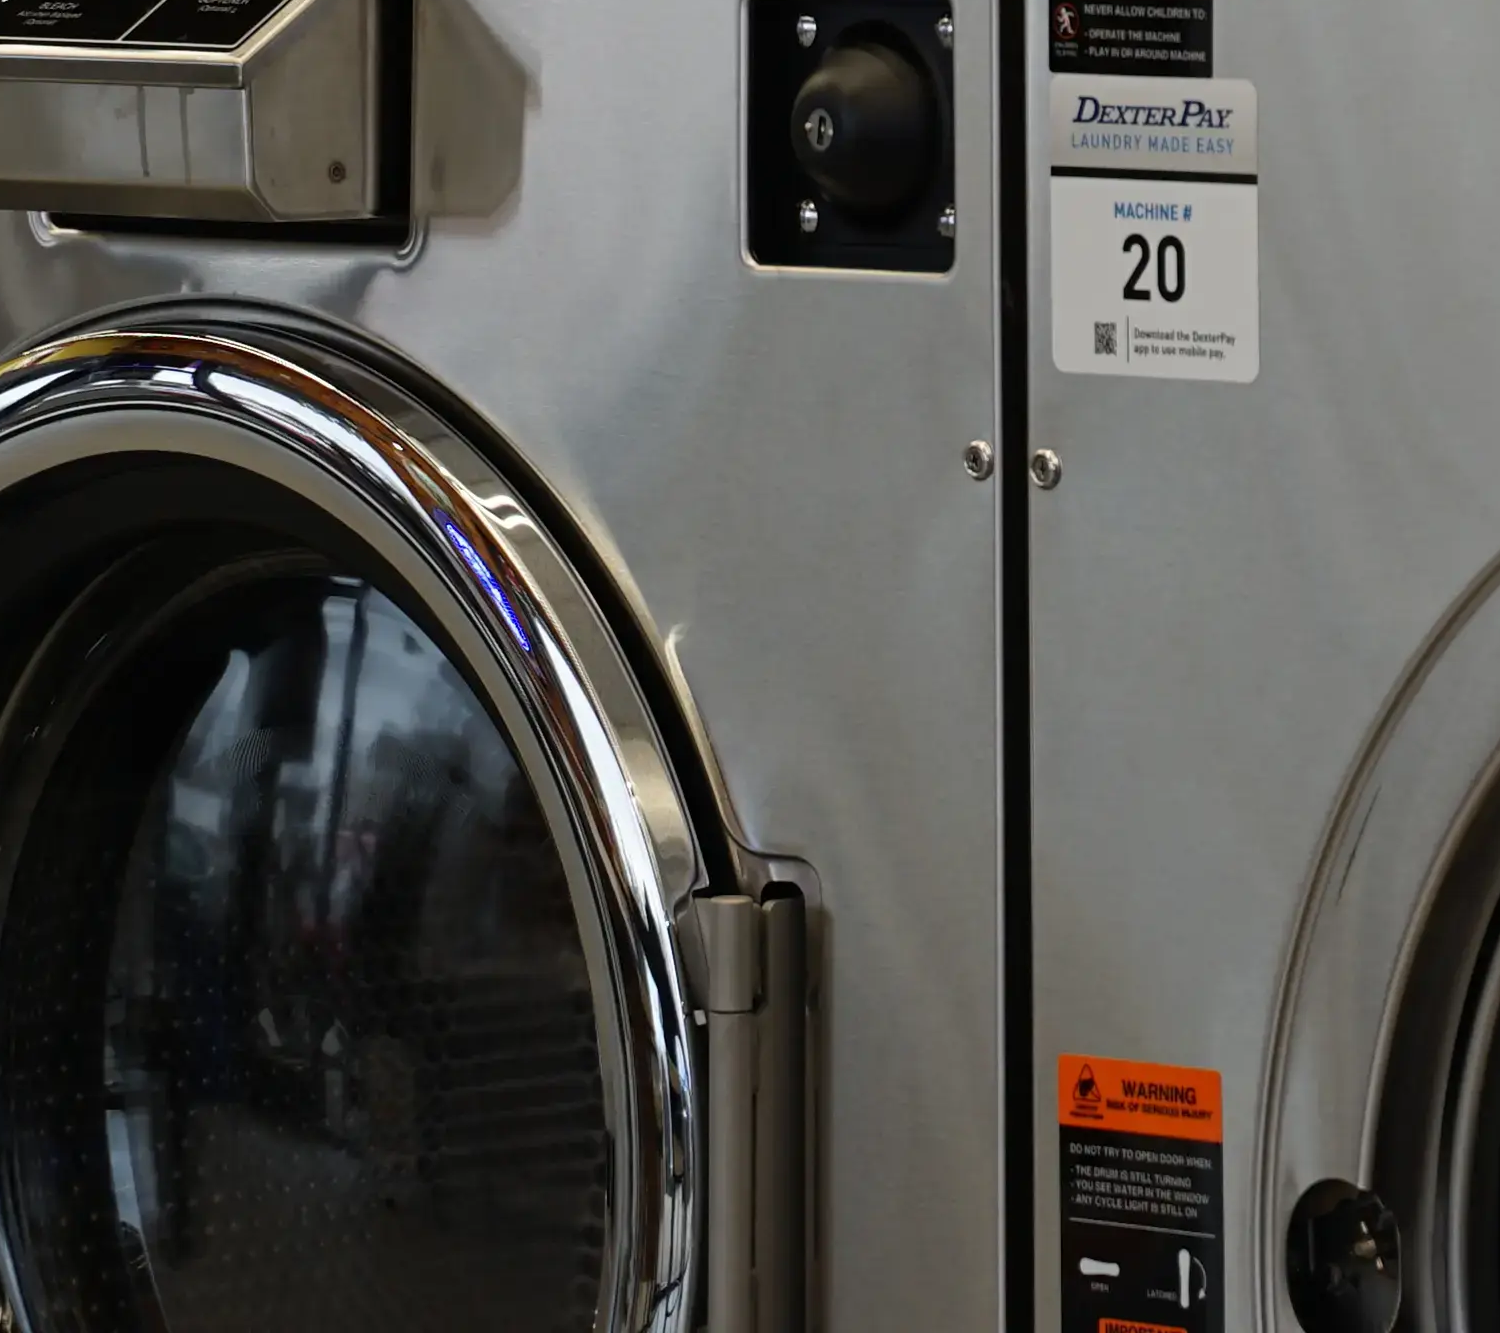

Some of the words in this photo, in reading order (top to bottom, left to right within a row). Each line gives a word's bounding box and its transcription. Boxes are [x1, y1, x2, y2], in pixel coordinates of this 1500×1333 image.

[1084, 3, 1114, 15] NEVER
[1114, 4, 1147, 17] ALLOW
[1147, 6, 1190, 19] CHILDREN
[1089, 46, 1109, 58] PLAY
[1071, 133, 1142, 152] LAUNDRY
[1148, 136, 1190, 153] MADE
[1196, 138, 1235, 154] EASY
[1114, 201, 1178, 221] MACHINE
[1183, 204, 1192, 221] #
[1122, 233, 1186, 303] 20
[1134, 328, 1176, 341] Download
[1177, 330, 1191, 342] the
[1192, 330, 1236, 346] DexterPay
[1134, 345, 1149, 357] app
[1151, 344, 1160, 355] to
[1162, 346, 1176, 356] use
[1178, 344, 1207, 357] mobile
[1122, 1079, 1197, 1105] WARNING
[1070, 1142, 1082, 1155] DO
[1084, 1144, 1102, 1157] NOT
[1104, 1146, 1121, 1159] TRY
[1122, 1148, 1134, 1160] TO
[1135, 1150, 1159, 1163] OPEN
[1160, 1153, 1184, 1166] DOOR
[1076, 1165, 1092, 1177] THE
[1076, 1180, 1094, 1193] YOU
[1114, 1183, 1144, 1198] WATER
[1156, 1188, 1174, 1201] THE
[1075, 1194, 1093, 1206] ANY
[1095, 1196, 1122, 1210] CYCLE
[1124, 1199, 1149, 1213] LIGHT
[1185, 1206, 1197, 1218] ON
